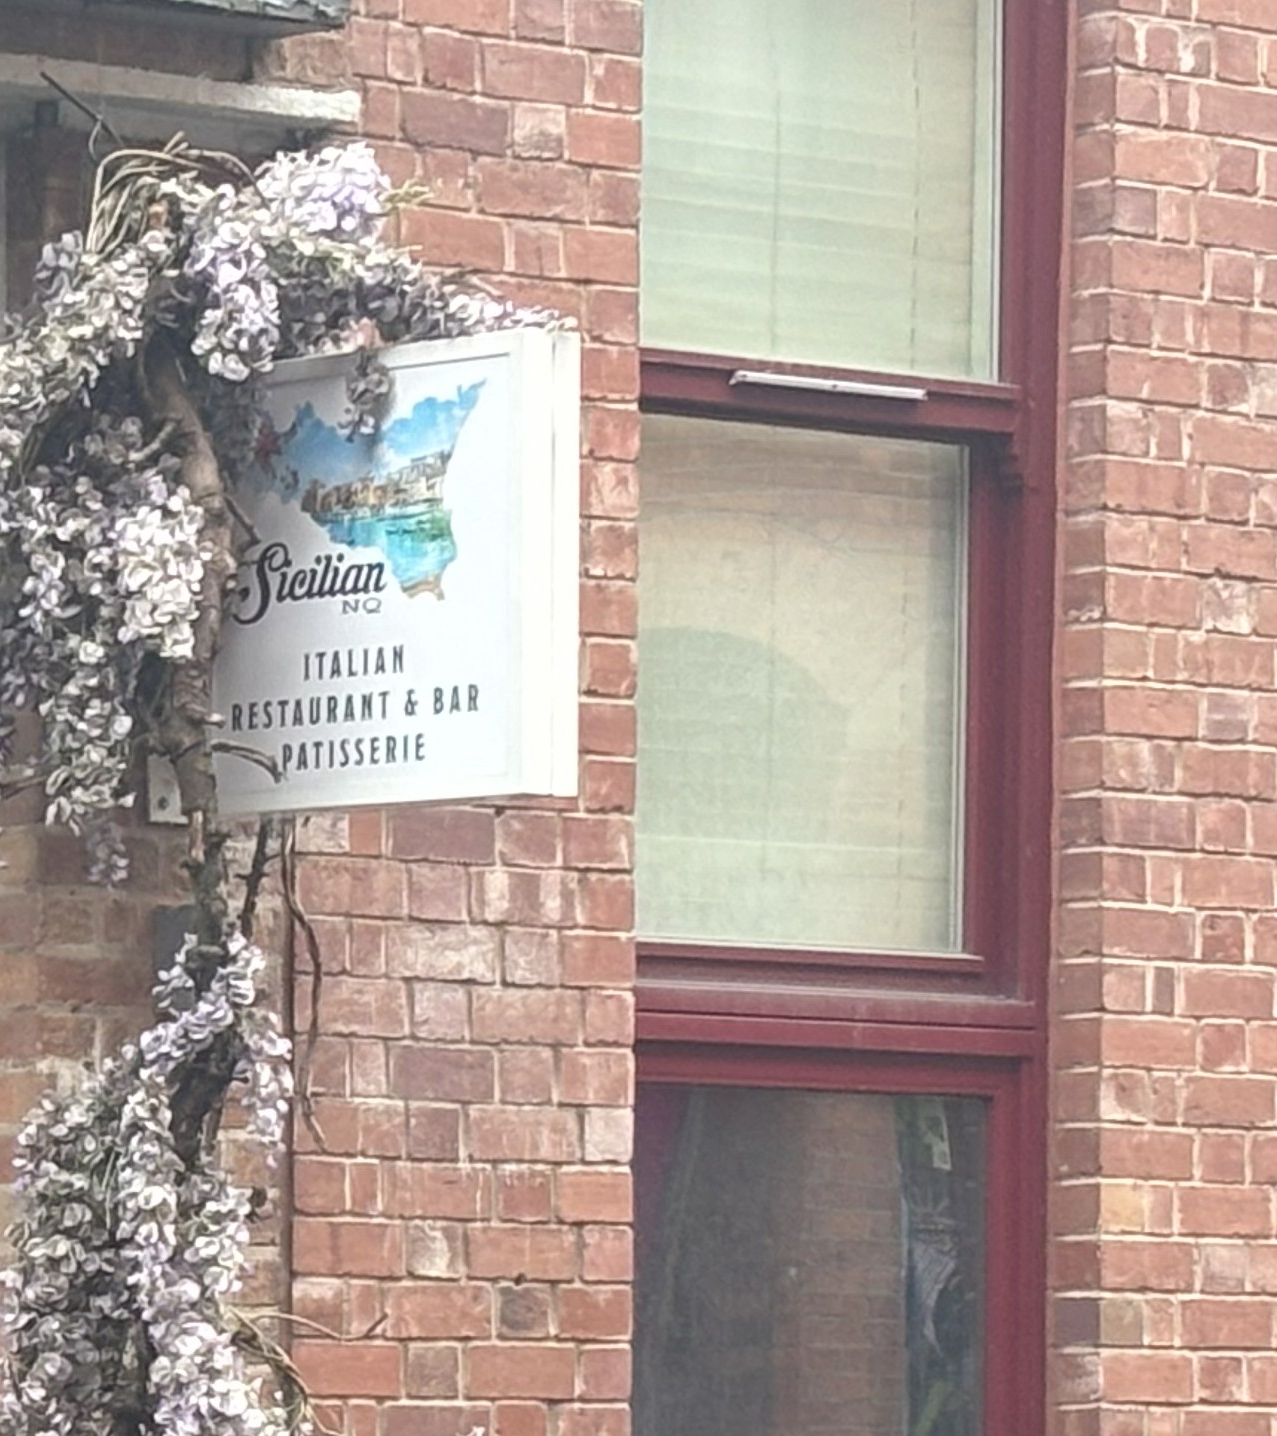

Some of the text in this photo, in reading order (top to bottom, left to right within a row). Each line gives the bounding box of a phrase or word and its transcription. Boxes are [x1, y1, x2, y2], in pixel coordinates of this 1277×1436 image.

[232, 541, 388, 626] Sicilian
[341, 598, 382, 615] NQ
[303, 643, 406, 682] ITALIAN
[231, 683, 481, 732] RESTAURANT & BAR
[281, 732, 427, 773] PATISSERIE
